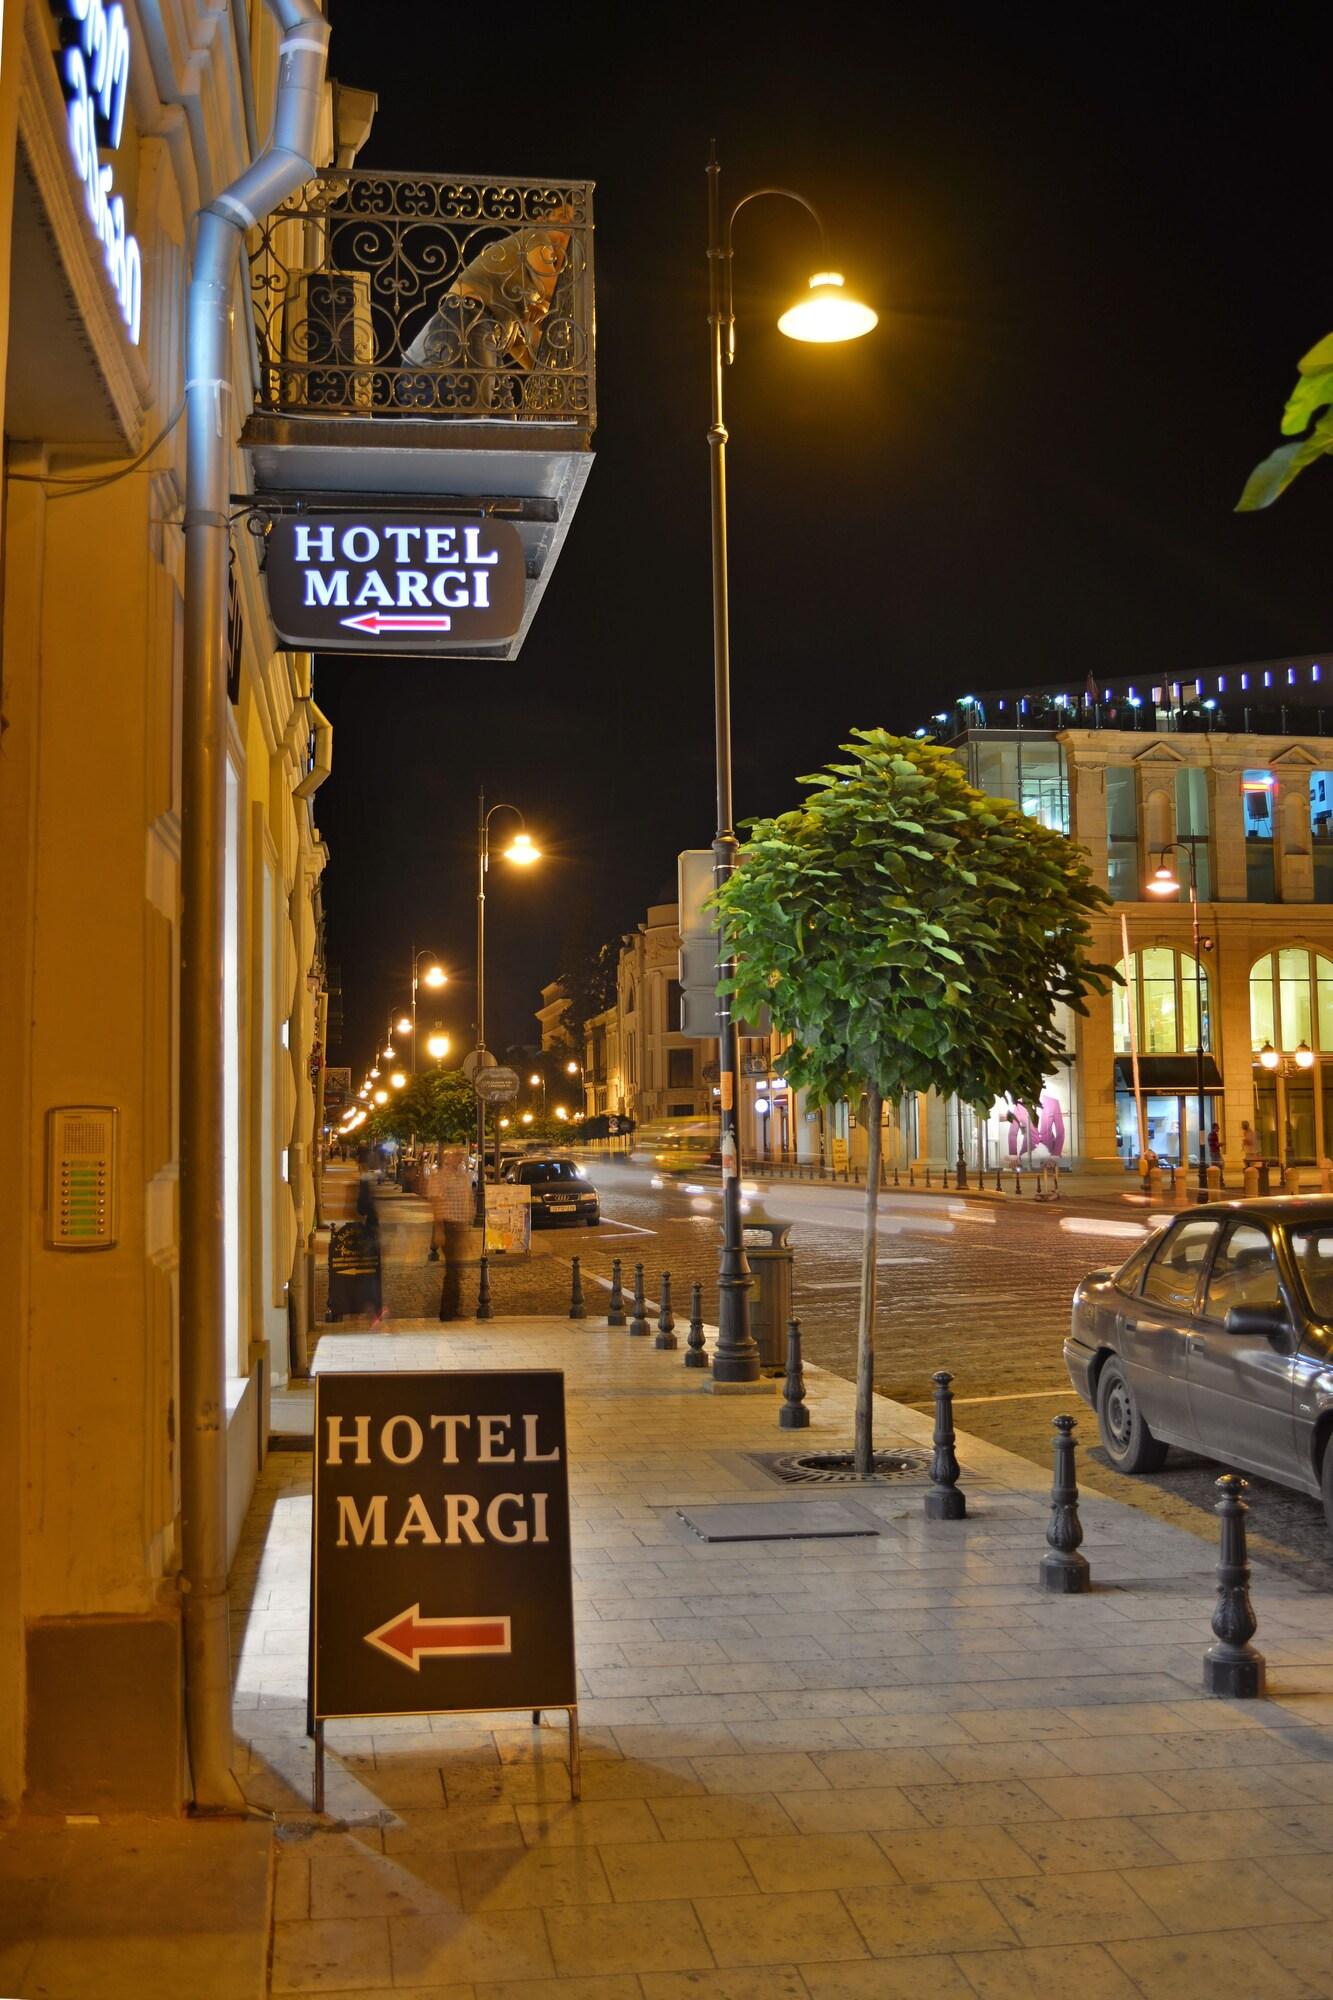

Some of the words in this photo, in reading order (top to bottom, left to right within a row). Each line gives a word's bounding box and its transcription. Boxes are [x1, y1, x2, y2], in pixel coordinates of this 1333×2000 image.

[294, 526, 499, 564] HOTEL
[304, 569, 490, 608] MARGI
[325, 1414, 560, 1465] HOTEL
[336, 1492, 550, 1546] MARGI
